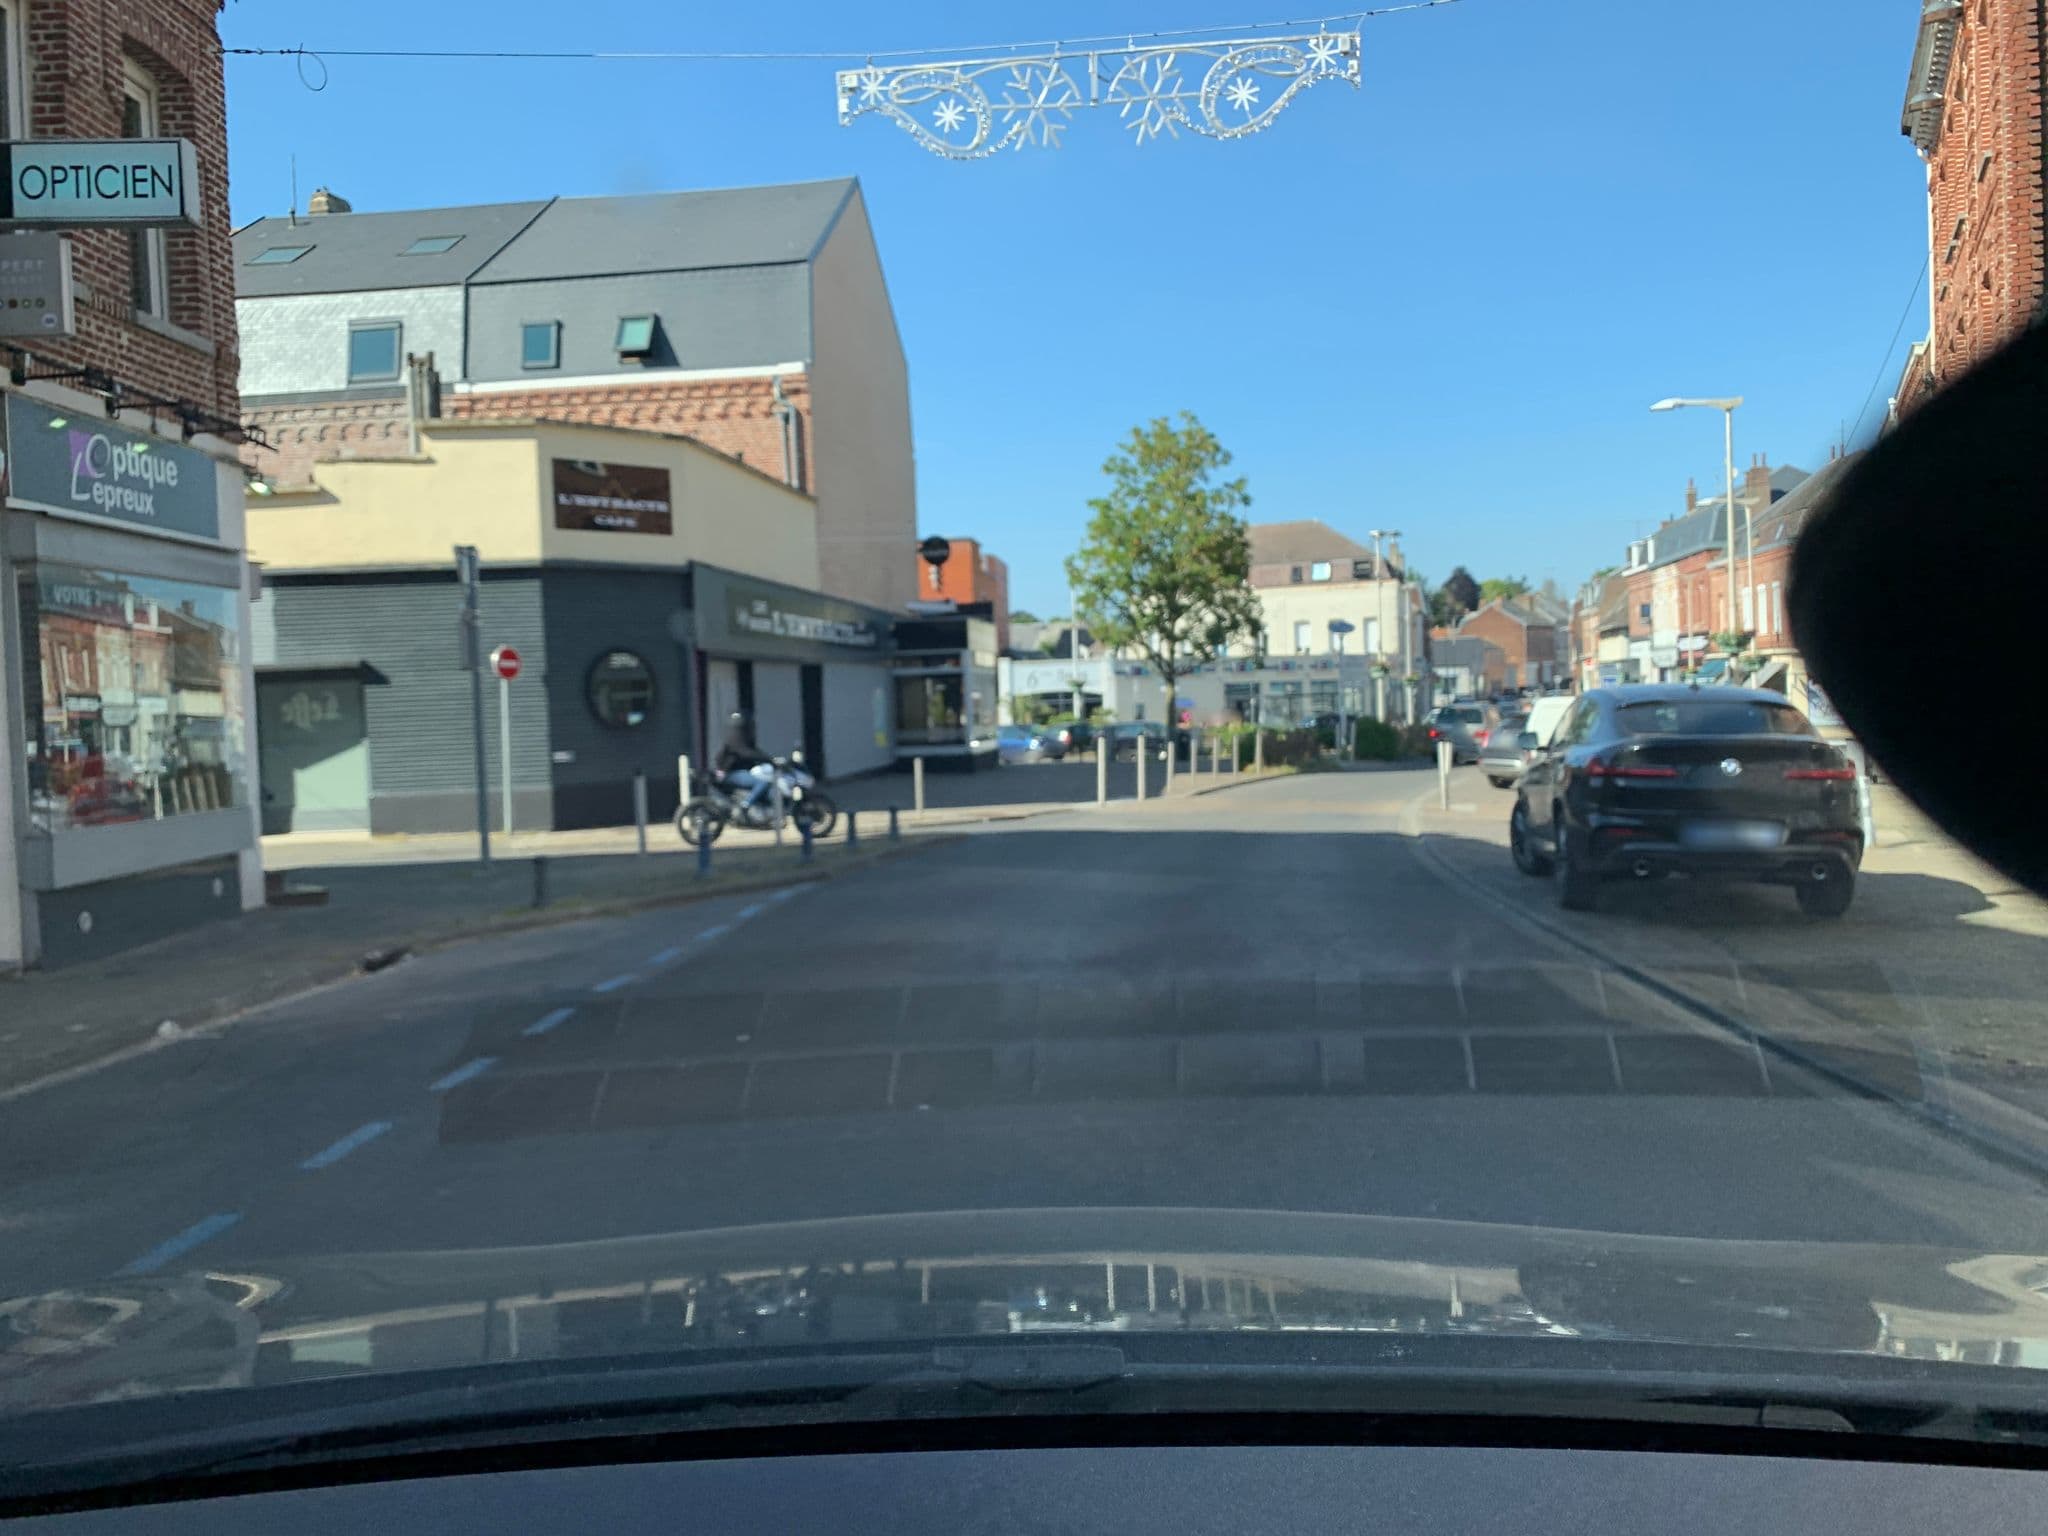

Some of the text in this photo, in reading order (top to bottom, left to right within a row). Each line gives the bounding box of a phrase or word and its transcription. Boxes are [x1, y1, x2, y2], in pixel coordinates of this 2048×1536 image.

[19, 165, 173, 199] OPTICIEN
[71, 452, 155, 516] Lepreux
[85, 433, 178, 490] Optique
